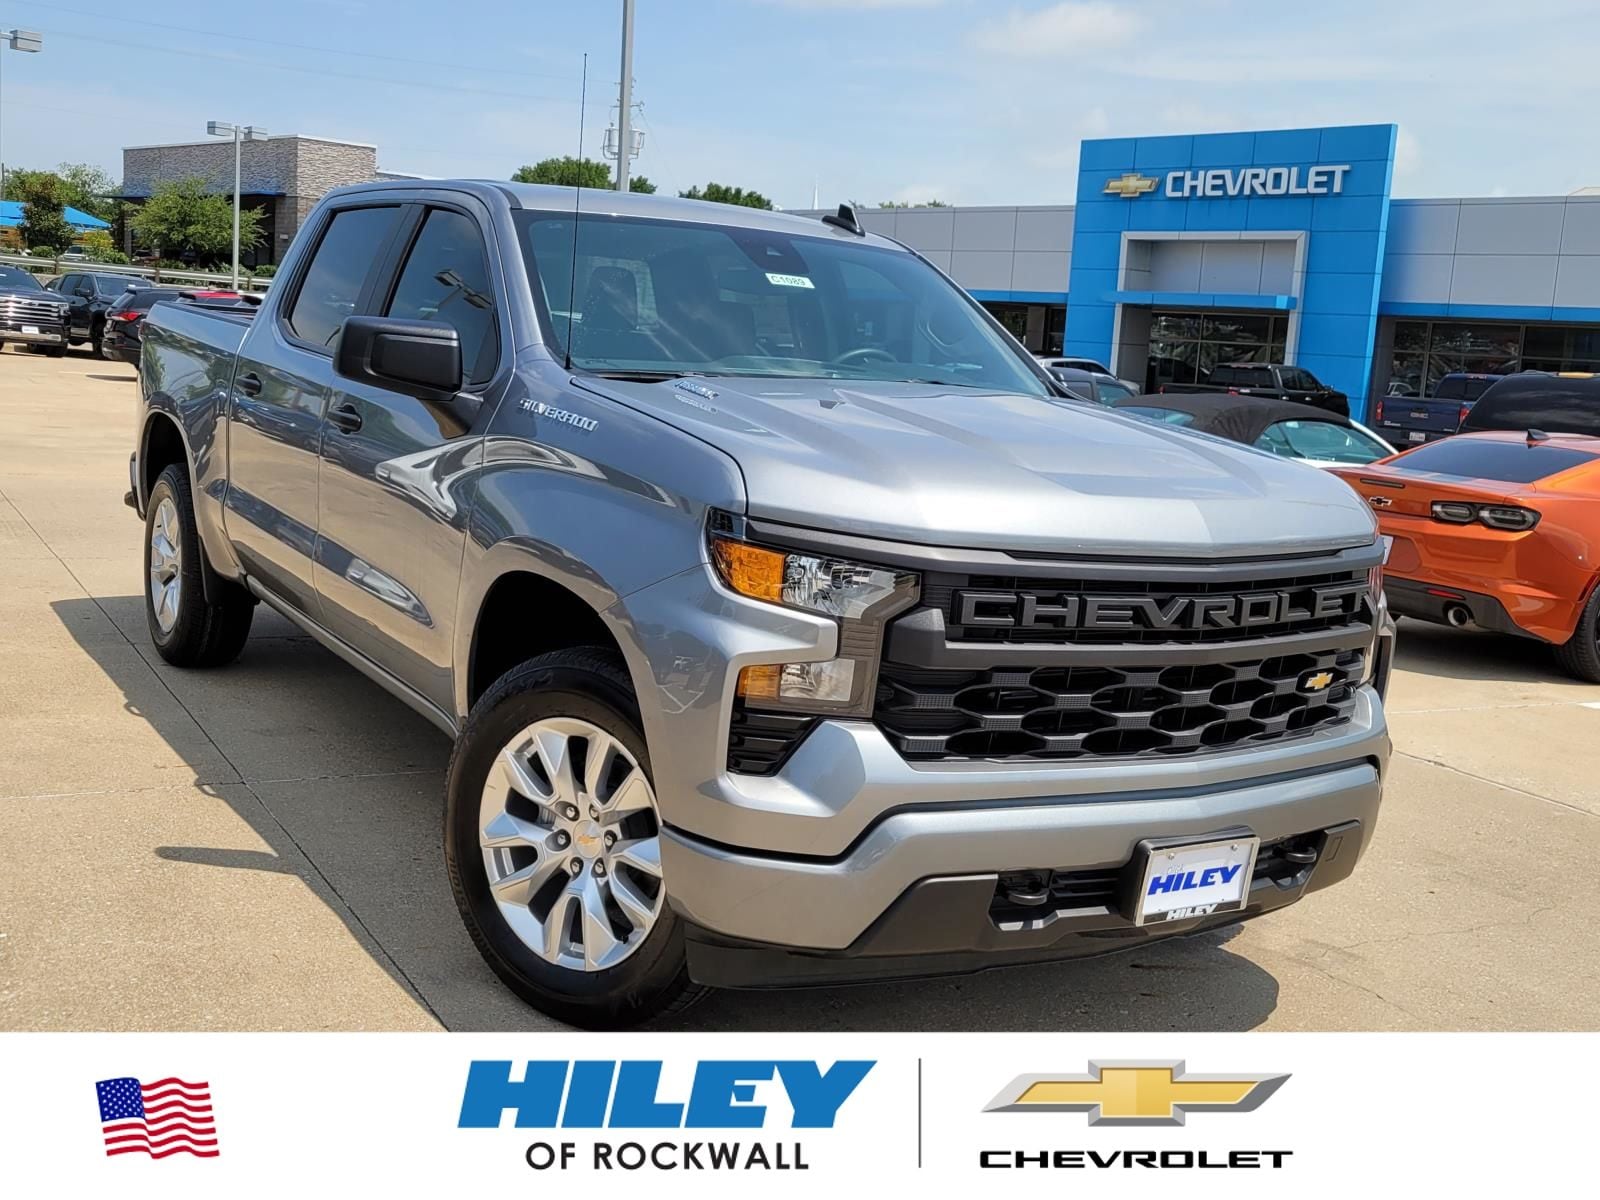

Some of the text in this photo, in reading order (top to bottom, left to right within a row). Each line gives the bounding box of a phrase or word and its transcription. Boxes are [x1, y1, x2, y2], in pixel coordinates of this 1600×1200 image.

[1166, 165, 1350, 197] CHEVROLET
[520, 398, 598, 431] SILVERADO
[958, 583, 1370, 628] CHEVROLET
[1147, 864, 1242, 896] HILEY
[1166, 903, 1218, 920] HILEY
